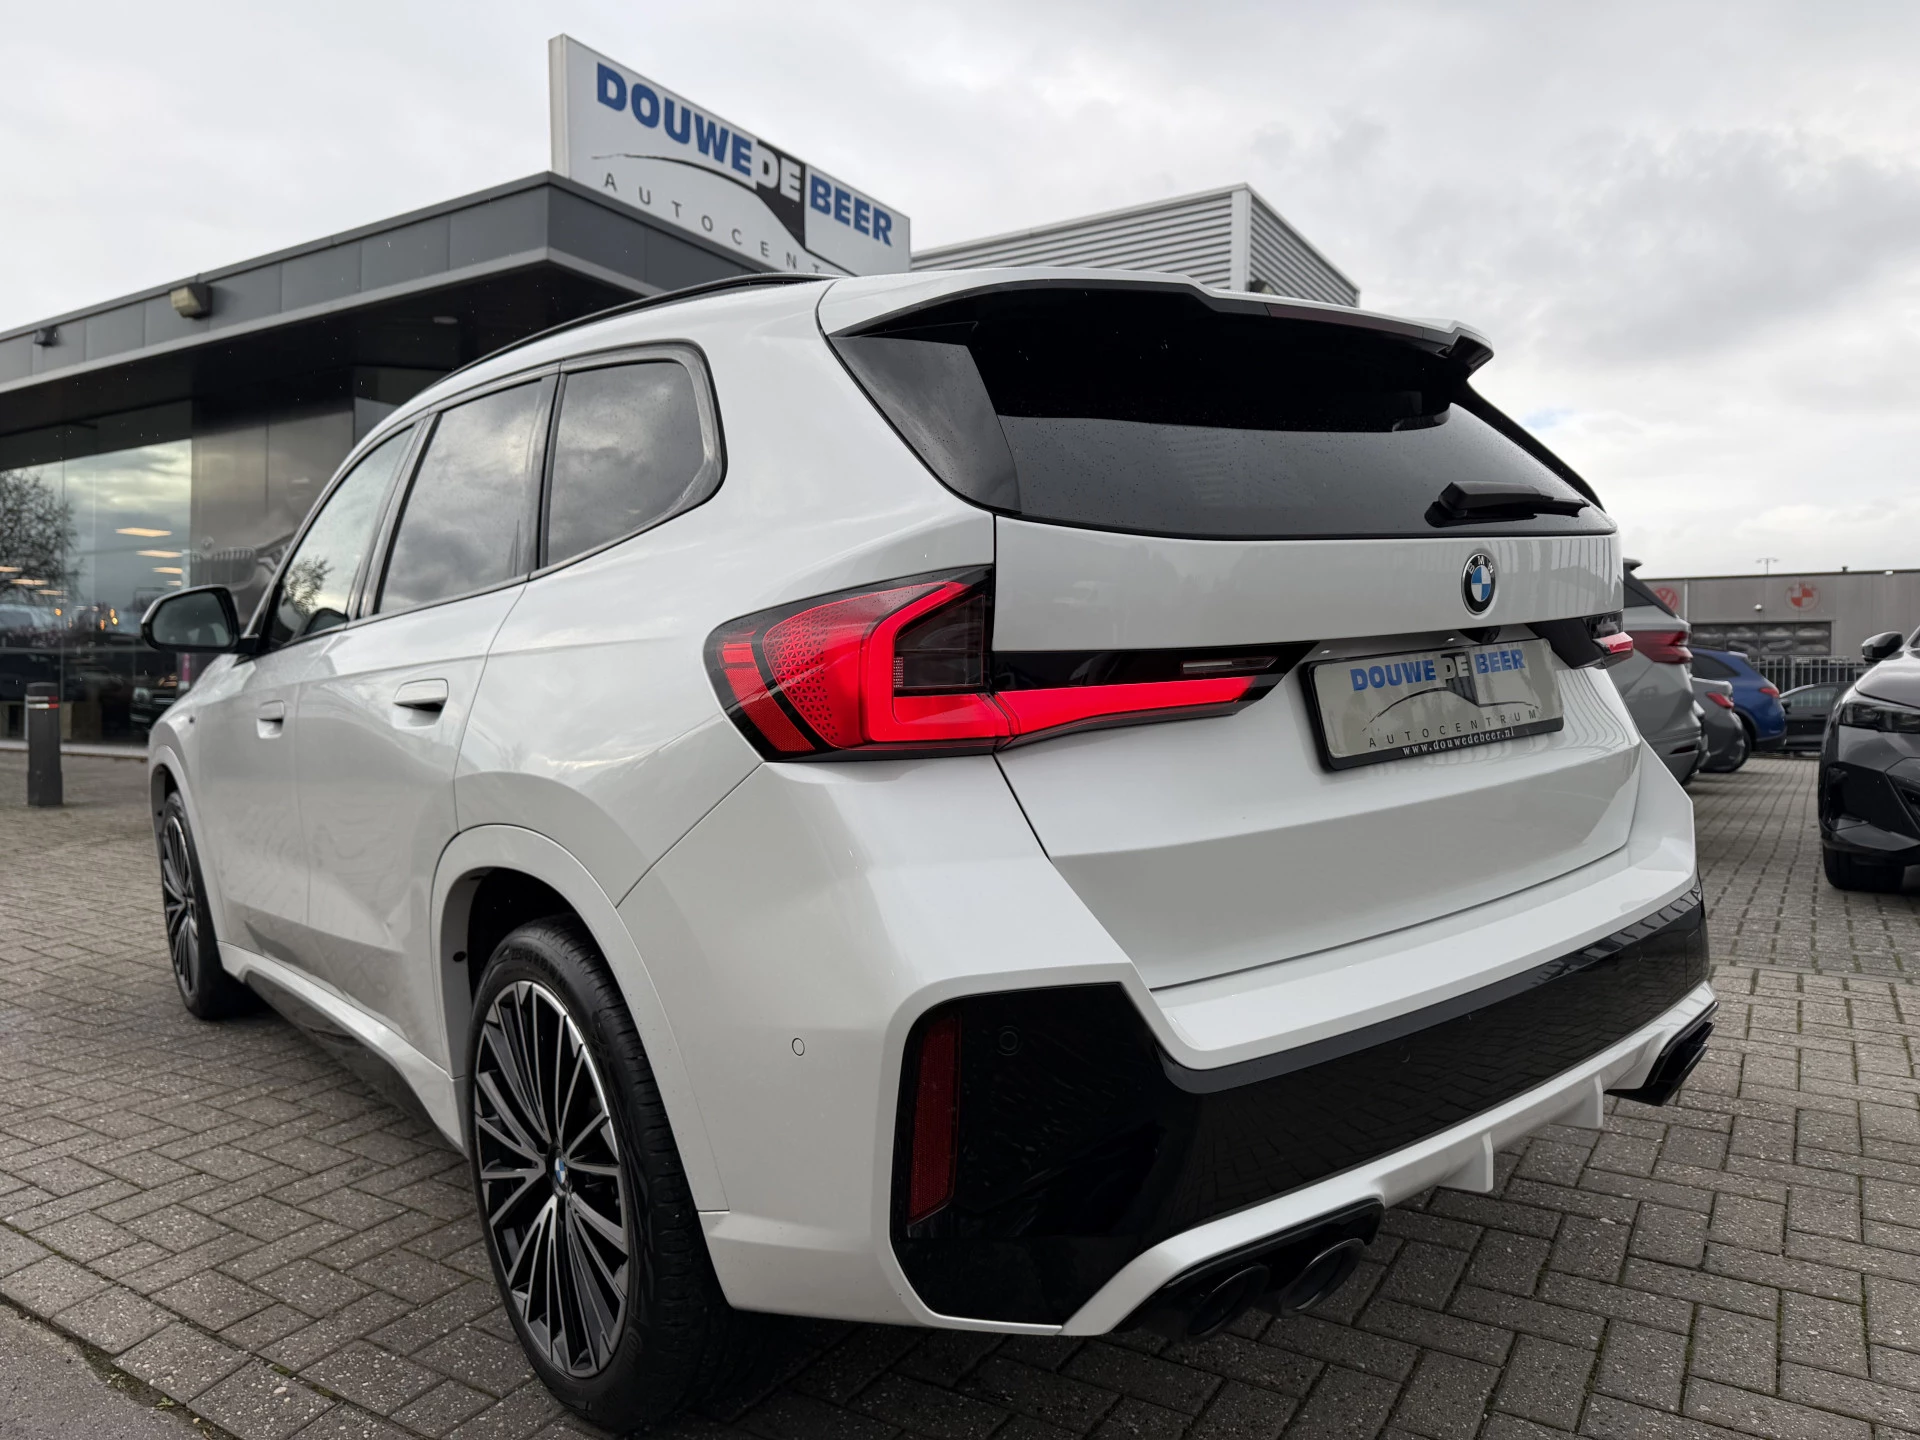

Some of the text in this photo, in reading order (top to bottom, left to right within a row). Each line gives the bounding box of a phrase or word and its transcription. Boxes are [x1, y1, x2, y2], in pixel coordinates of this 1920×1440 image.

[596, 62, 893, 247] DOUWE DE BEER
[1350, 649, 1526, 691] DOUWE DE BEER
[1368, 709, 1537, 748] AUTOCENTRUM
[1402, 727, 1515, 756] www.douwedebeer.nl
